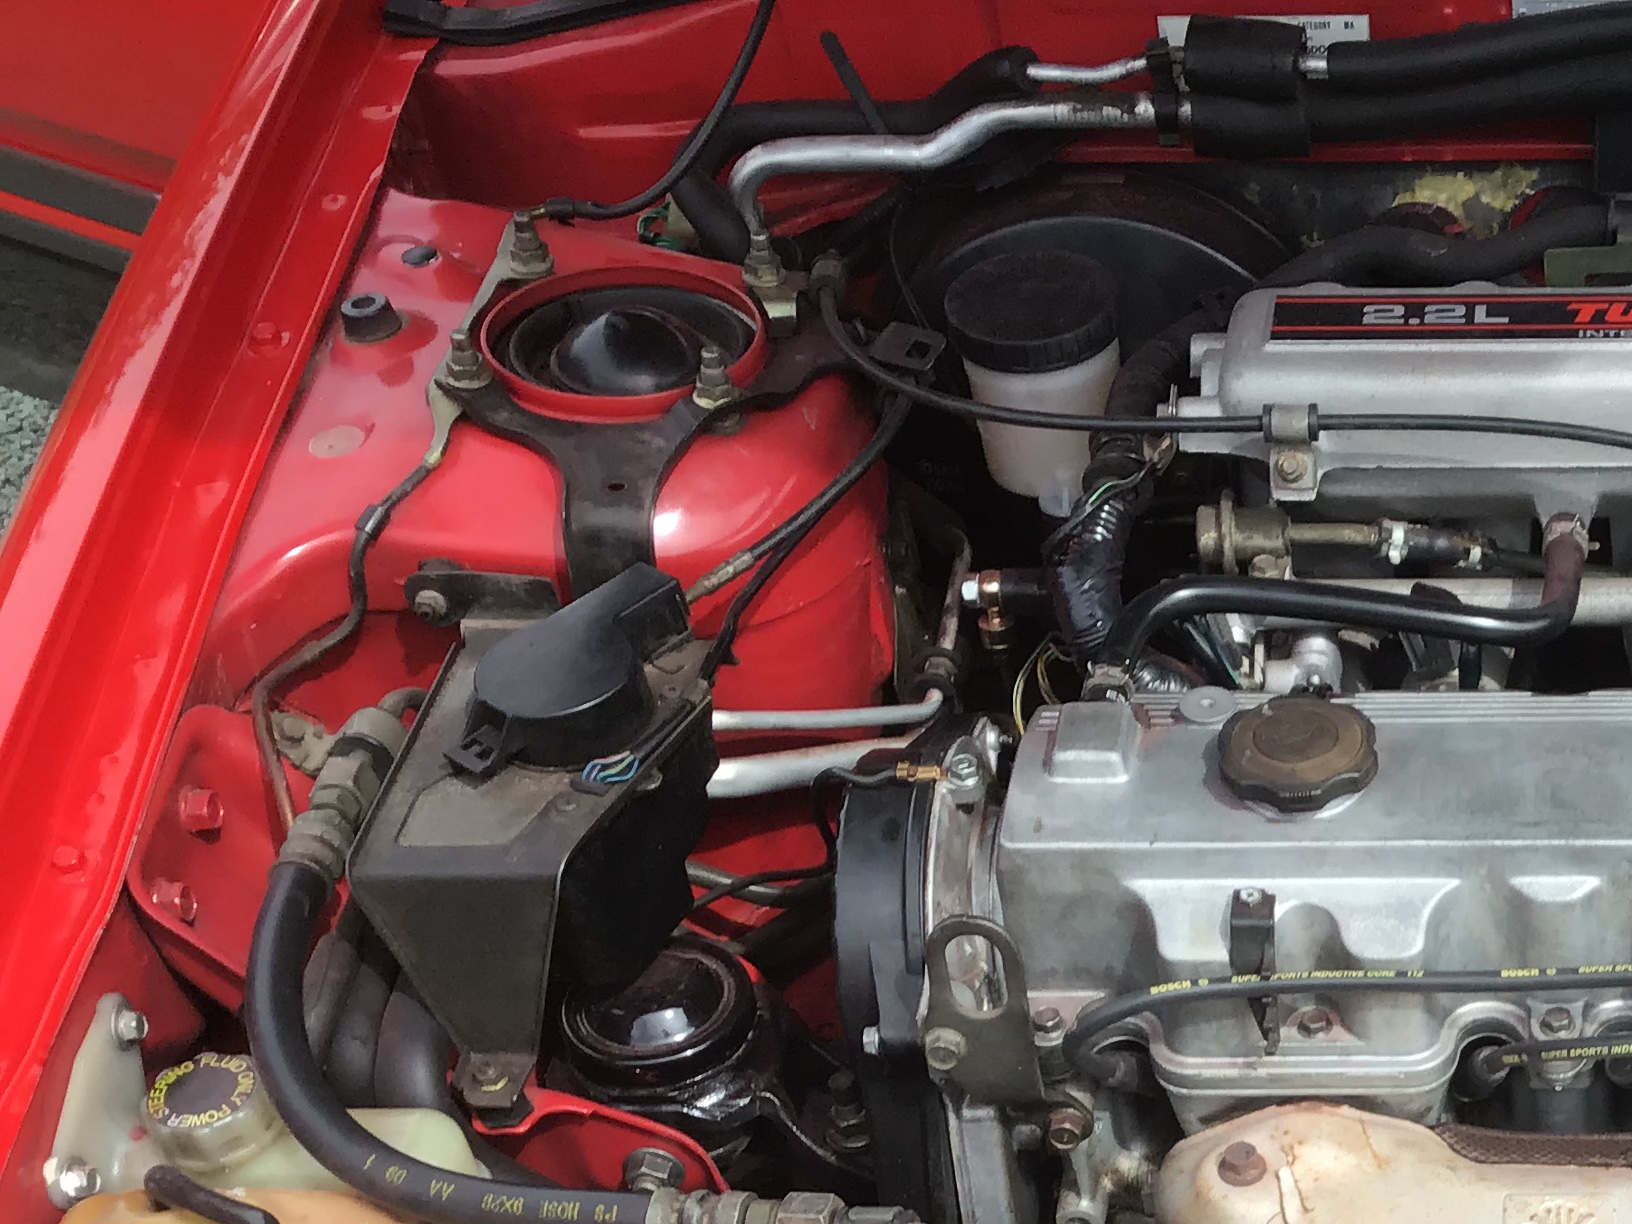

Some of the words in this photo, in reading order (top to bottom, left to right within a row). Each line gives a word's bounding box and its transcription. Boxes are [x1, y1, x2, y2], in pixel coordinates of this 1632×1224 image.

[1361, 303, 1510, 325] 2.2L
[1578, 965, 1613, 975] SUPER
[1150, 980, 1192, 996] BOSCH
[1310, 969, 1365, 979] INDUCTIVE
[1569, 1045, 1609, 1059] SPORTS
[166, 1103, 232, 1128] POWER
